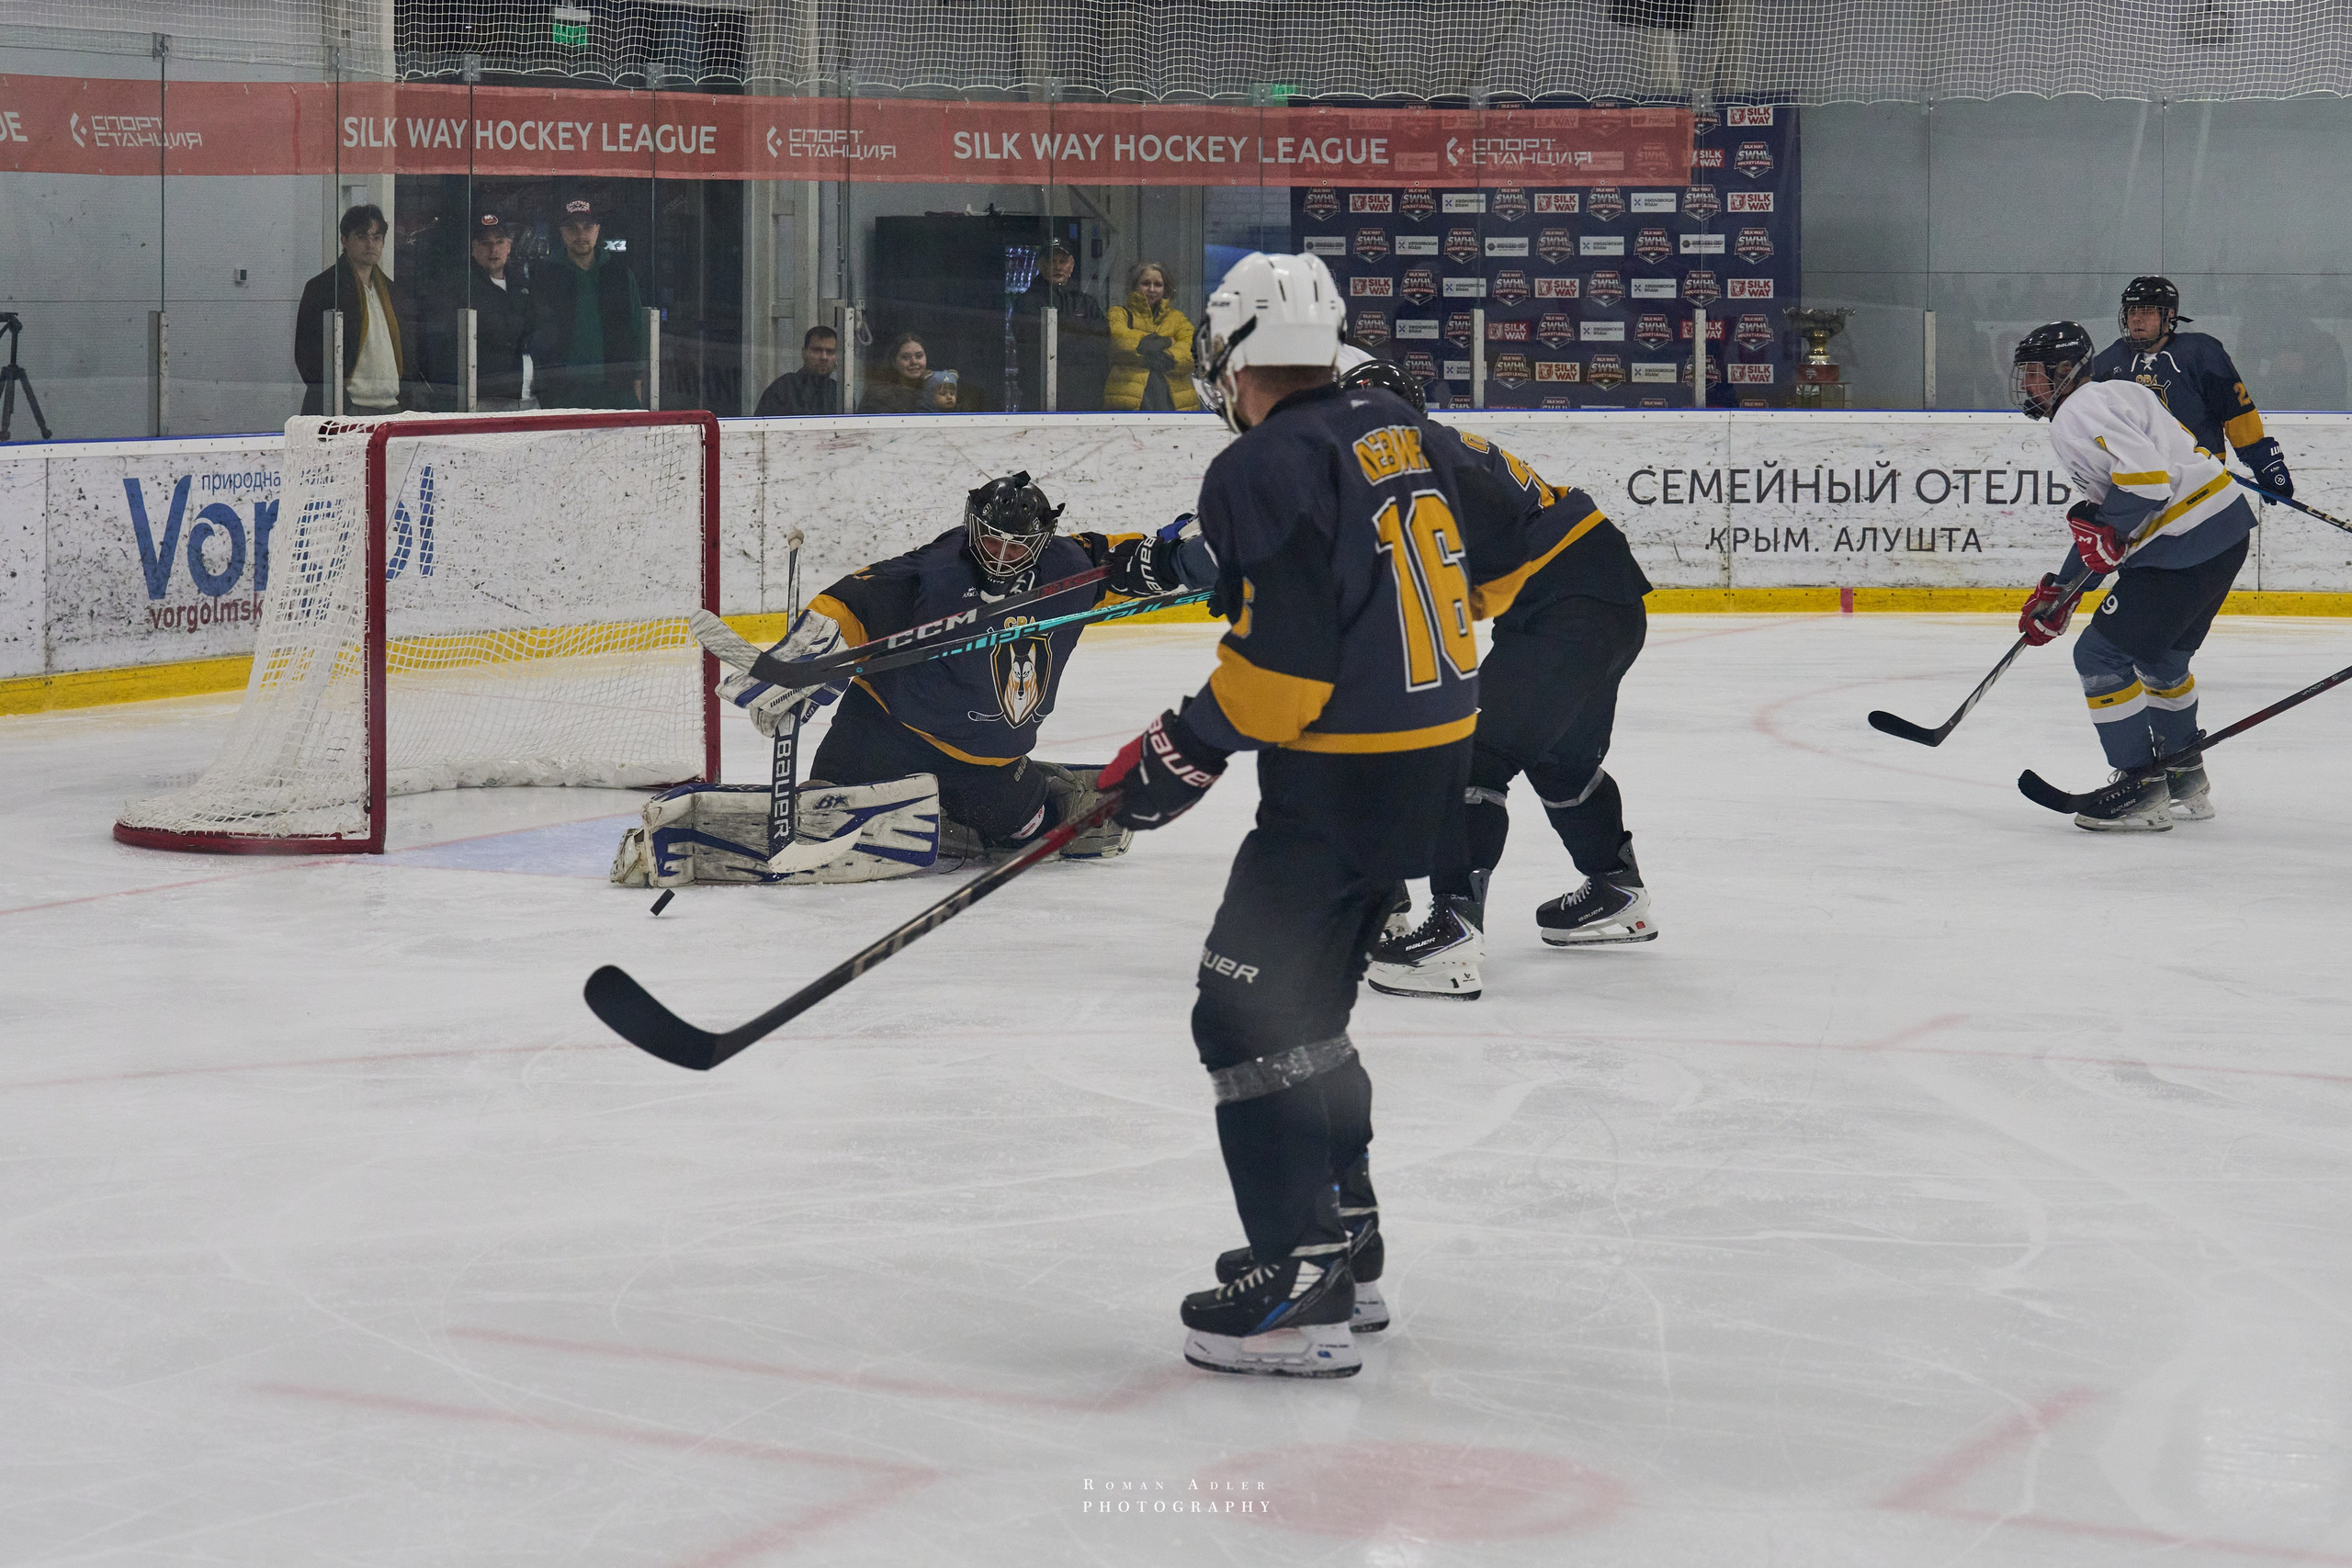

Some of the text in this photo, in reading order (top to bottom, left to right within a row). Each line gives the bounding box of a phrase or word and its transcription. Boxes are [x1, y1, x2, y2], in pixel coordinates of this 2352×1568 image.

[1747, 107, 1770, 116] SILK
[92, 115, 162, 131] СПОРТ
[1747, 116, 1770, 125] WAY
[95, 131, 203, 150] СТАНЦИЯ
[343, 116, 718, 154] SILK WAY HOCKEY LEAGUE
[789, 128, 864, 143] СПОРТ
[789, 143, 897, 161] СТАНЦИЯ
[953, 130, 1389, 164] SILK WAY HOCKEY LEAGUE
[1472, 138, 1555, 152] СПОРТ
[1472, 152, 1592, 167] СТАНЦИЯ
[1368, 195, 1390, 203] SILK
[1554, 195, 1576, 203] SILK
[1747, 194, 1770, 202] SILK
[1747, 202, 1770, 210] WAY
[1369, 287, 1390, 295] WAY
[1554, 280, 1577, 288] SILK
[1555, 288, 1577, 297] WAY
[1504, 323, 1526, 332] SILK
[1706, 322, 1722, 331] ILK
[1505, 332, 1526, 340] WAY
[1555, 364, 1577, 372] SILK
[1555, 372, 1577, 380] WAY
[1627, 460, 2070, 505] СЕМЕЙНЫЙ ОТЕЛЬ
[1710, 527, 1982, 552] КРЫМ. АЛУШТА
[1372, 489, 1478, 692] 16
[887, 608, 978, 649] CCM
[774, 739, 792, 839] BAUER
[1577, 906, 1604, 922] BAUER
[1405, 937, 1437, 952] BAUER
[1203, 950, 1260, 984] UER
